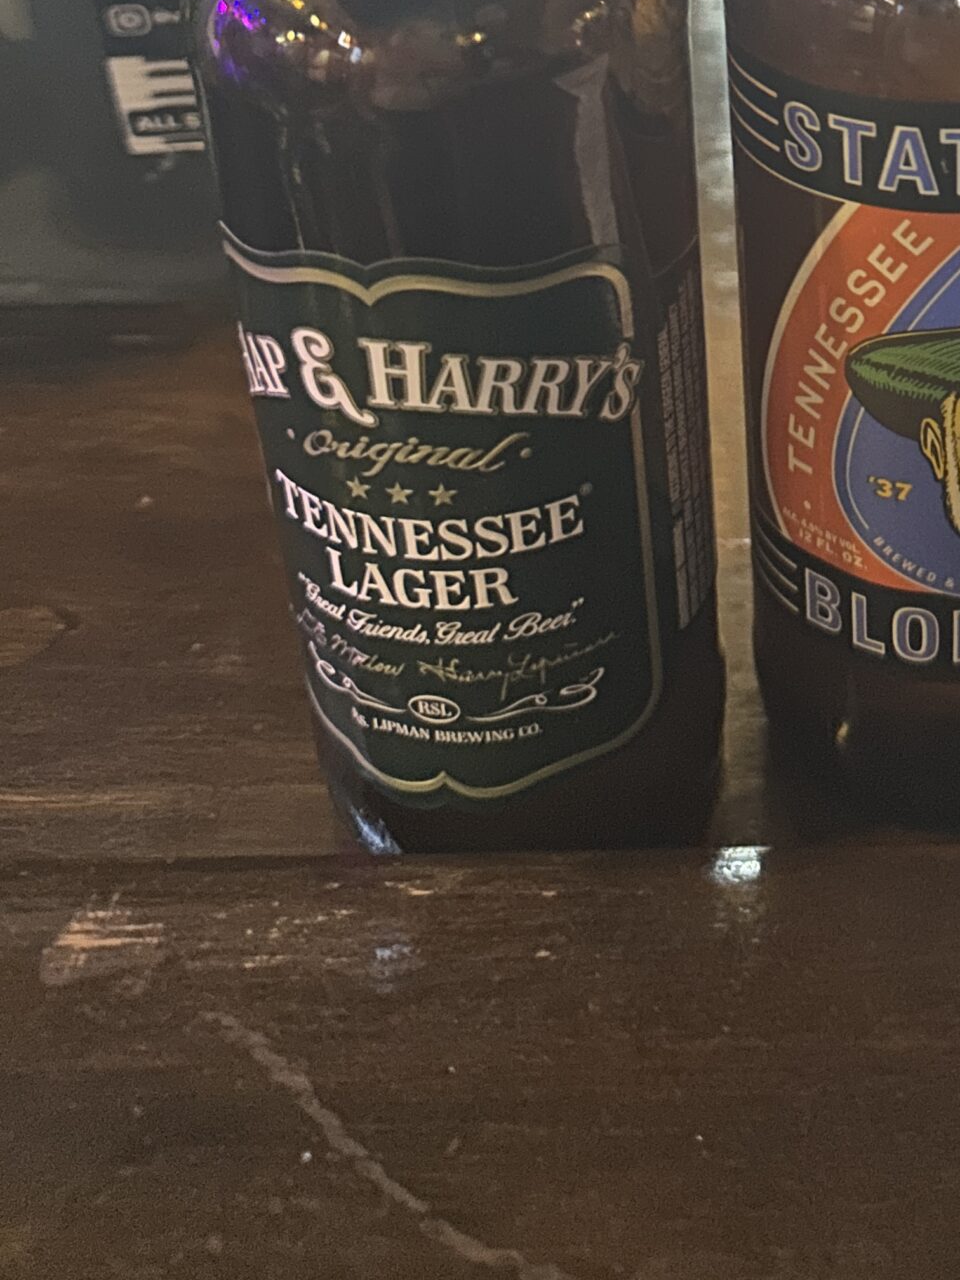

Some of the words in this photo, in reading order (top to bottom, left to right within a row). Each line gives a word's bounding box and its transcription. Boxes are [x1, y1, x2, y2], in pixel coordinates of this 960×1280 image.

[787, 218, 933, 475] TENNESSEE
[291, 326, 379, 428] &
[356, 335, 646, 421] HARRY'S
[302, 429, 530, 477] Original
[274, 468, 586, 563] TENNESSEE
[326, 546, 519, 612] LAGER
[872, 535, 936, 583] BREWED
[434, 620, 502, 645] Great
[372, 717, 431, 742] LIPMAN
[434, 727, 515, 744] BREWING
